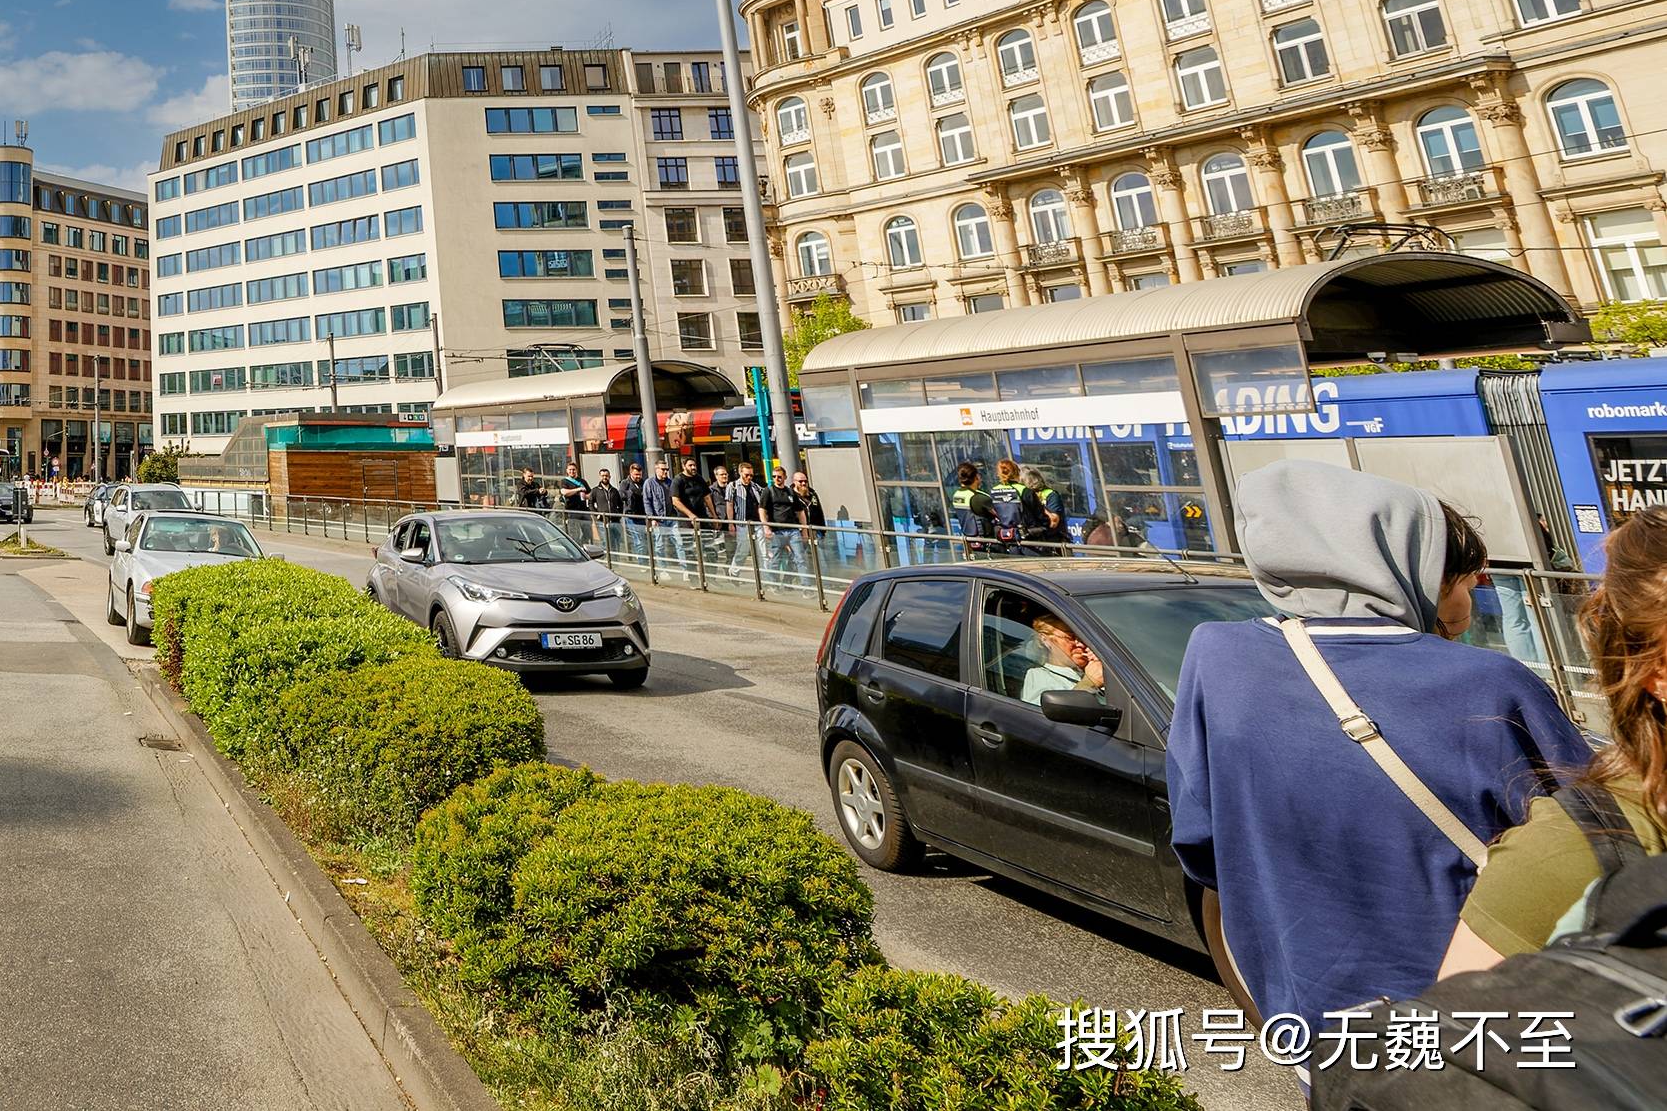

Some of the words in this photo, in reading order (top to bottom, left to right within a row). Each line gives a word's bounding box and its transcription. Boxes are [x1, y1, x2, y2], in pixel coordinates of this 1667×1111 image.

[980, 407, 1040, 425] Hauptbahnhof
[1587, 401, 1667, 419] robomark
[1611, 489, 1667, 512] HAN
